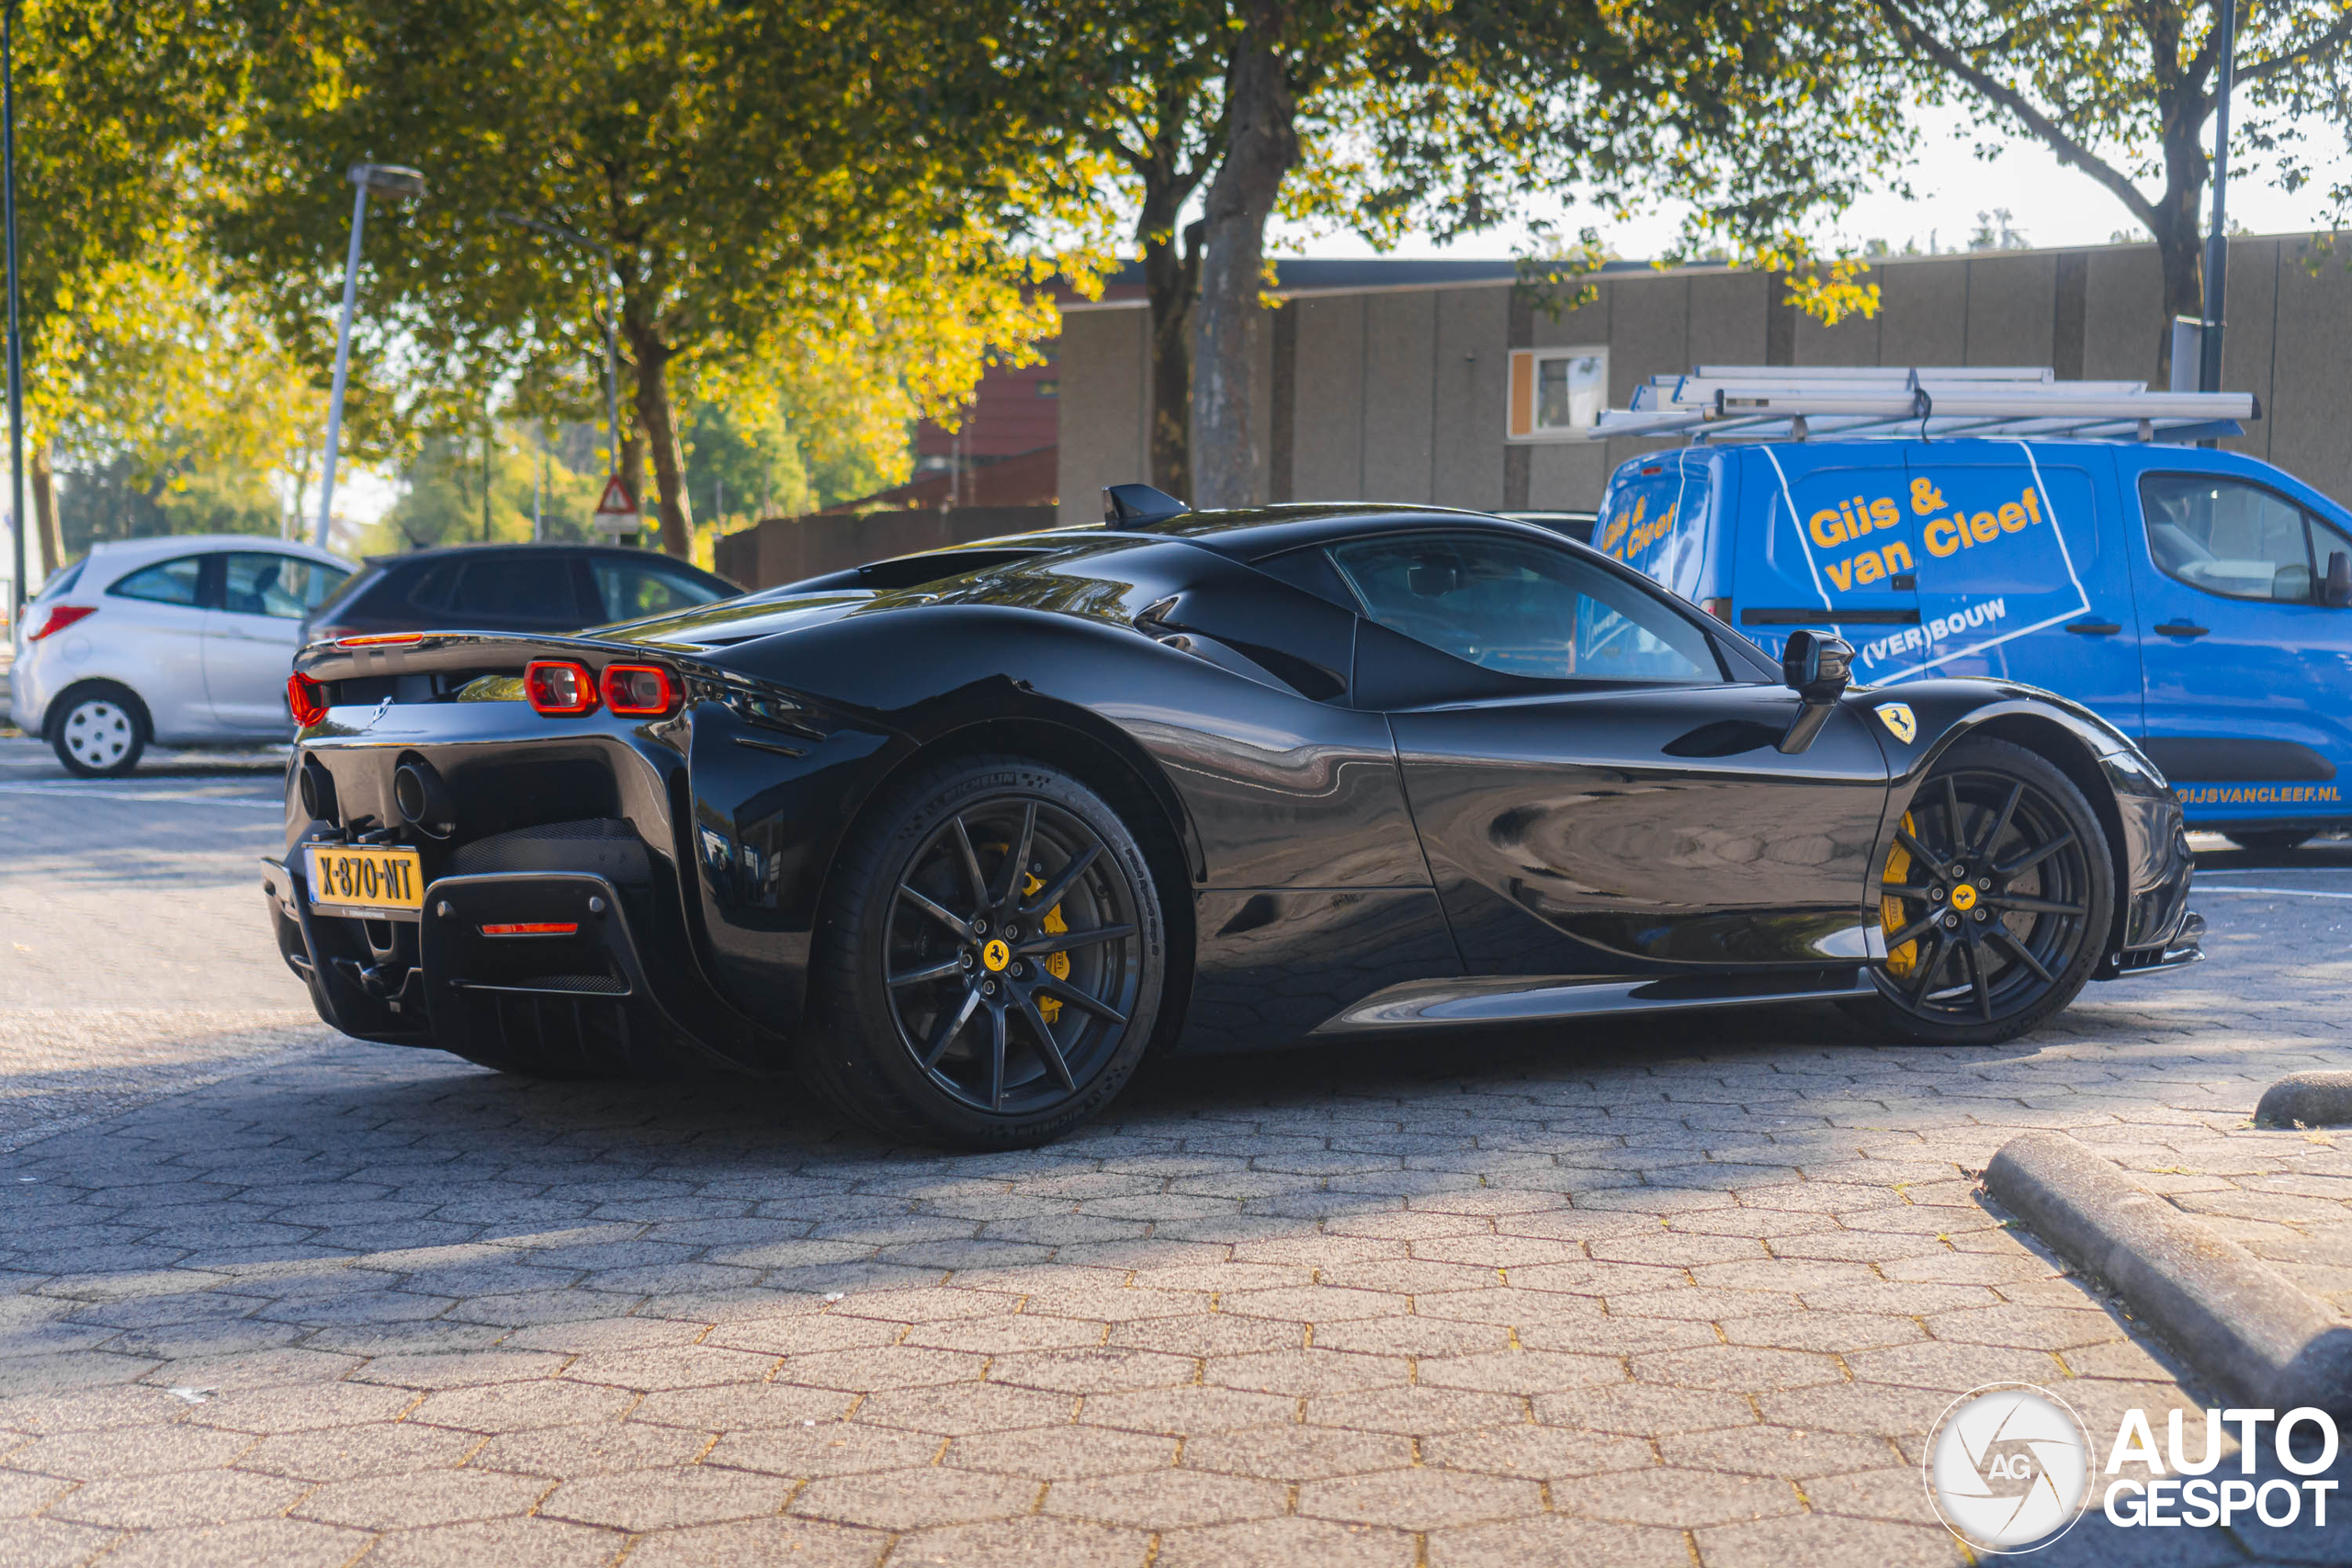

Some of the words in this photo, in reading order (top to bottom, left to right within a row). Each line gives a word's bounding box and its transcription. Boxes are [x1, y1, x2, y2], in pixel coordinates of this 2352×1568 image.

[1627, 502, 1676, 559] Cleef
[1809, 496, 1900, 548] Gijs
[1910, 477, 1948, 515] &
[1825, 540, 1914, 592] van
[1924, 487, 2041, 558] Cleef
[1862, 598, 2006, 669] (VER)BOUW
[2176, 786, 2342, 804] GIJSVANCLEEF.NL
[320, 857, 411, 900] X-870-NT
